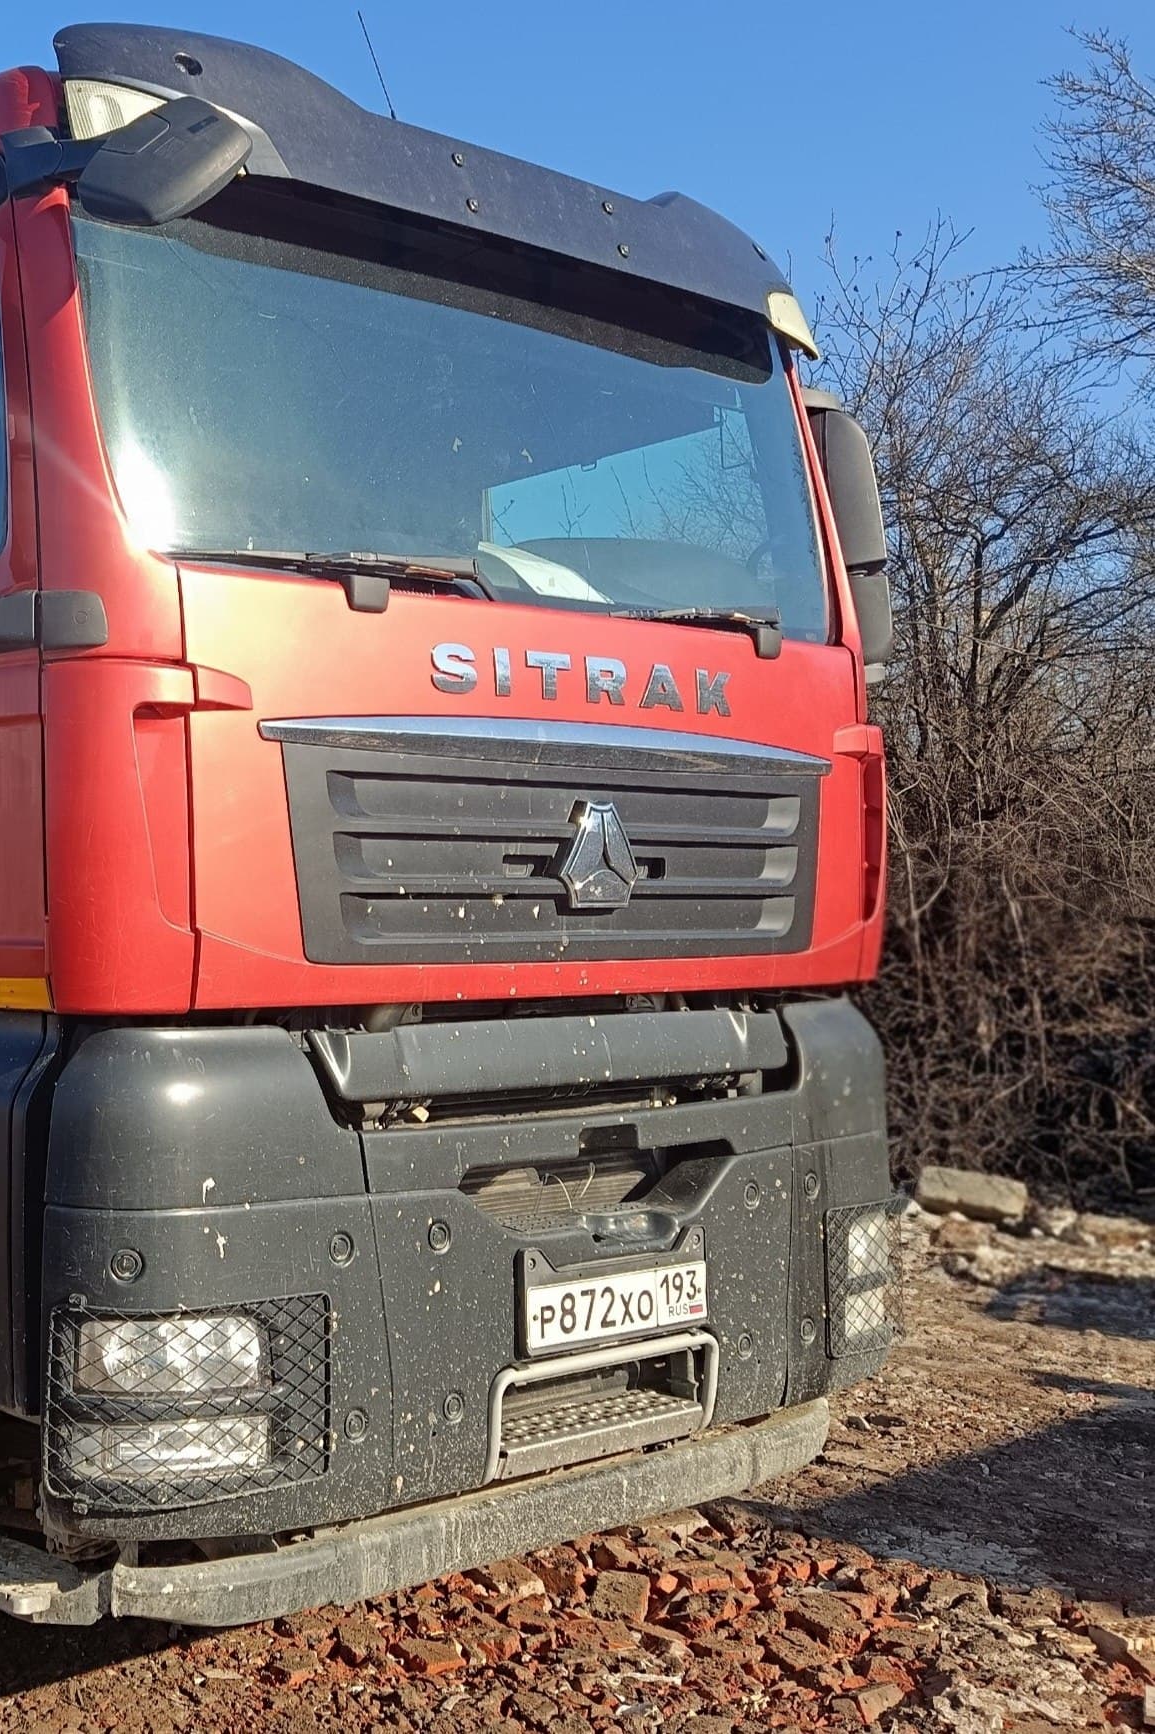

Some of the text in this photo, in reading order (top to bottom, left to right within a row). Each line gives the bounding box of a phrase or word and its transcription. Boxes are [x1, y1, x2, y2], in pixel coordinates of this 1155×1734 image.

[431, 642, 732, 717] SITRAK
[659, 1270, 697, 1305] 193
[668, 1303, 689, 1318] RUS
